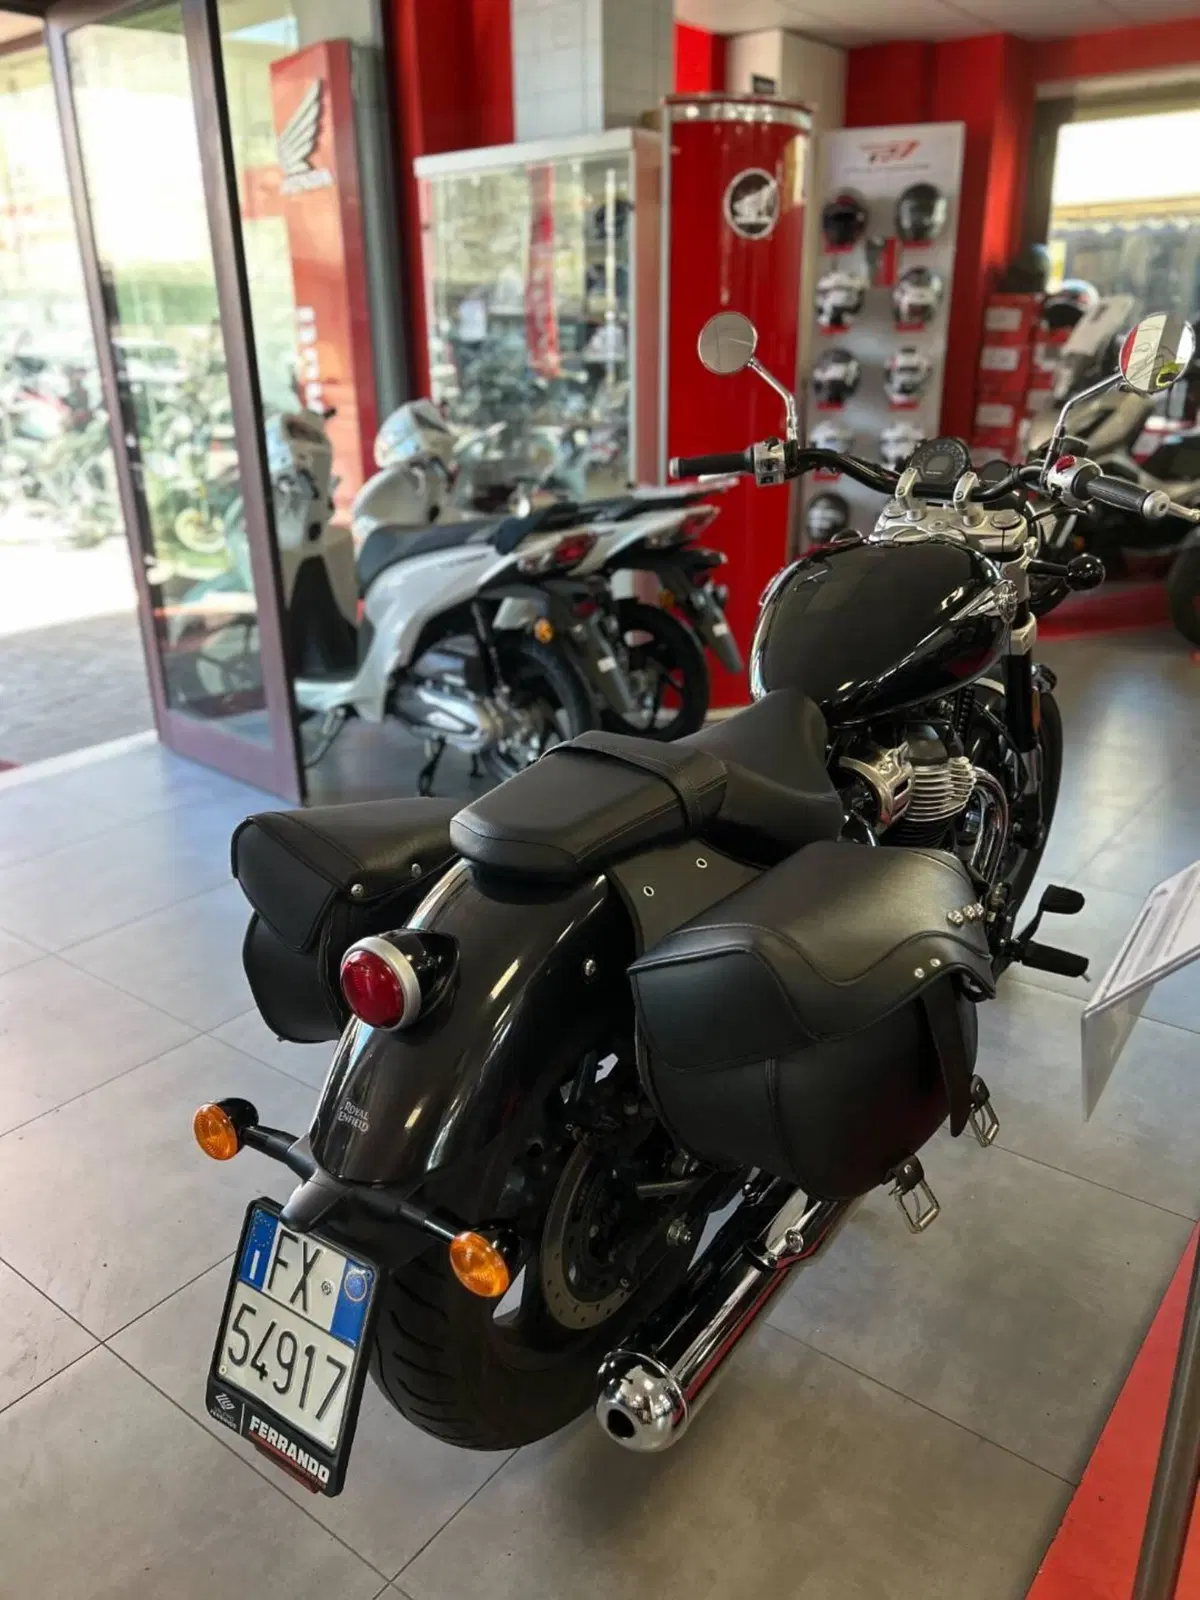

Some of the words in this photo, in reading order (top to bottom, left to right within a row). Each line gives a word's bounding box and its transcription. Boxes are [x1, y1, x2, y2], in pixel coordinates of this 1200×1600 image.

[339, 1111, 369, 1132] ENFIELD
[344, 1101, 369, 1120] ROYAL
[267, 1229, 322, 1314] FX
[228, 1303, 347, 1421] 54917
[249, 1415, 330, 1484] FERRANDO
